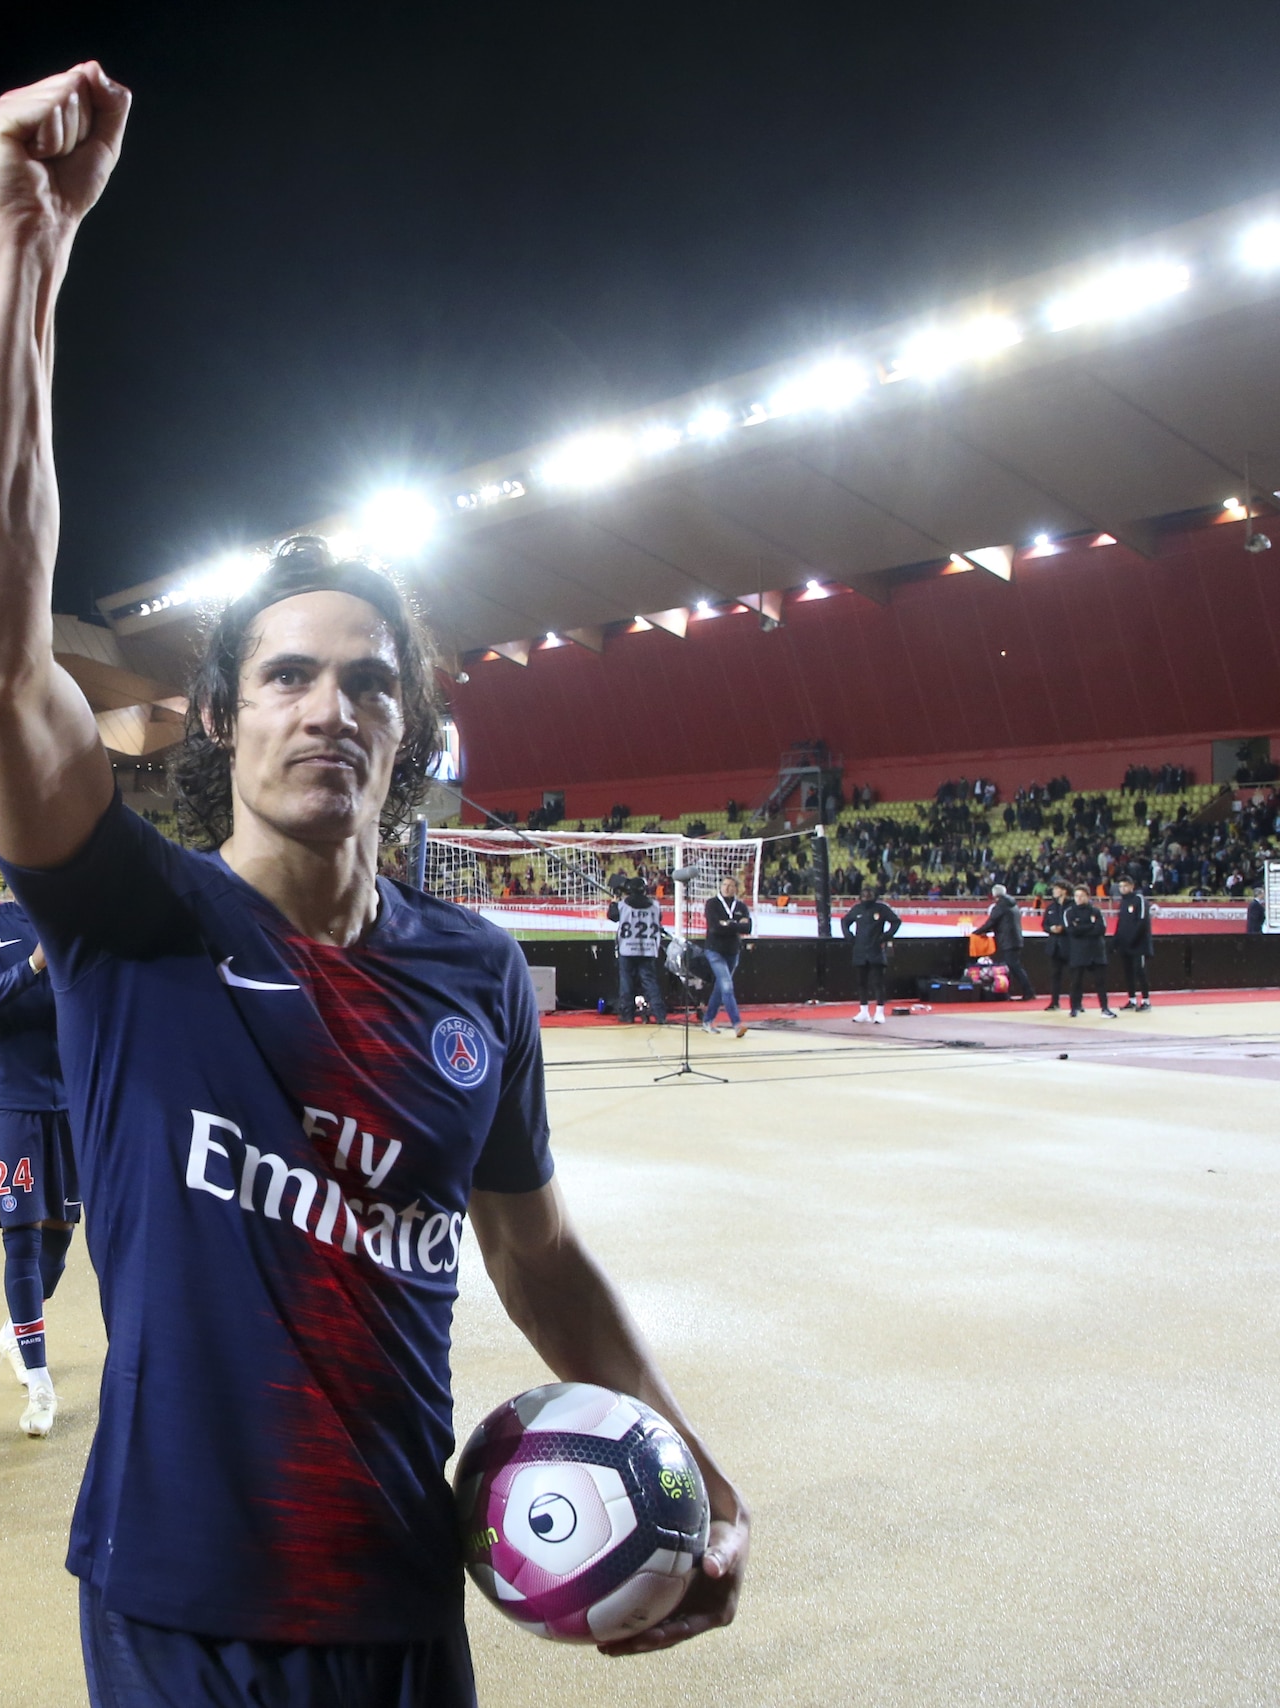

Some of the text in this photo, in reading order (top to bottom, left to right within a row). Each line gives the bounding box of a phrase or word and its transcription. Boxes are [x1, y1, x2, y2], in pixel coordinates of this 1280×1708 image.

[620, 921, 659, 939] 822
[439, 1020, 476, 1038] PARIS
[302, 1106, 403, 1190] Fly
[185, 1109, 464, 1274] Emirates
[20, 1337, 42, 1346] PARIS
